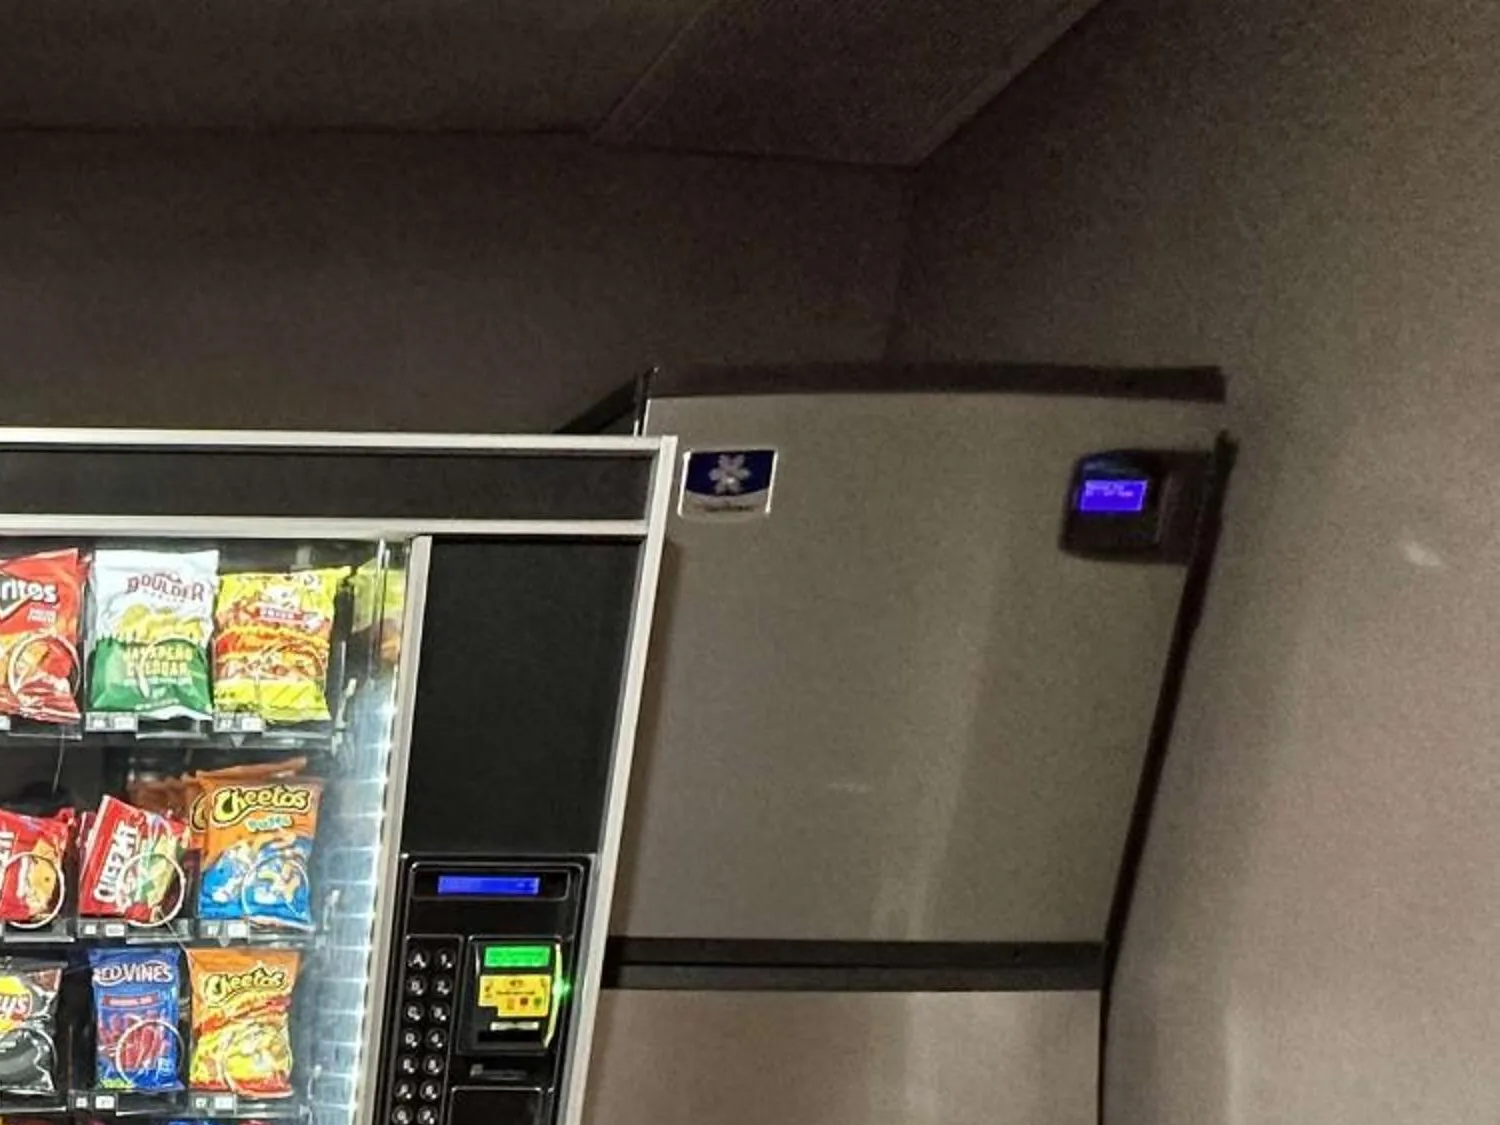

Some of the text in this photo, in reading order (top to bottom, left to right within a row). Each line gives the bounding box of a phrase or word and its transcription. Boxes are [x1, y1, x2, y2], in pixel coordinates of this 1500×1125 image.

[124, 573, 206, 603] BOULDER
[212, 784, 312, 827] Cheetos
[204, 966, 288, 1000] Cheetos
